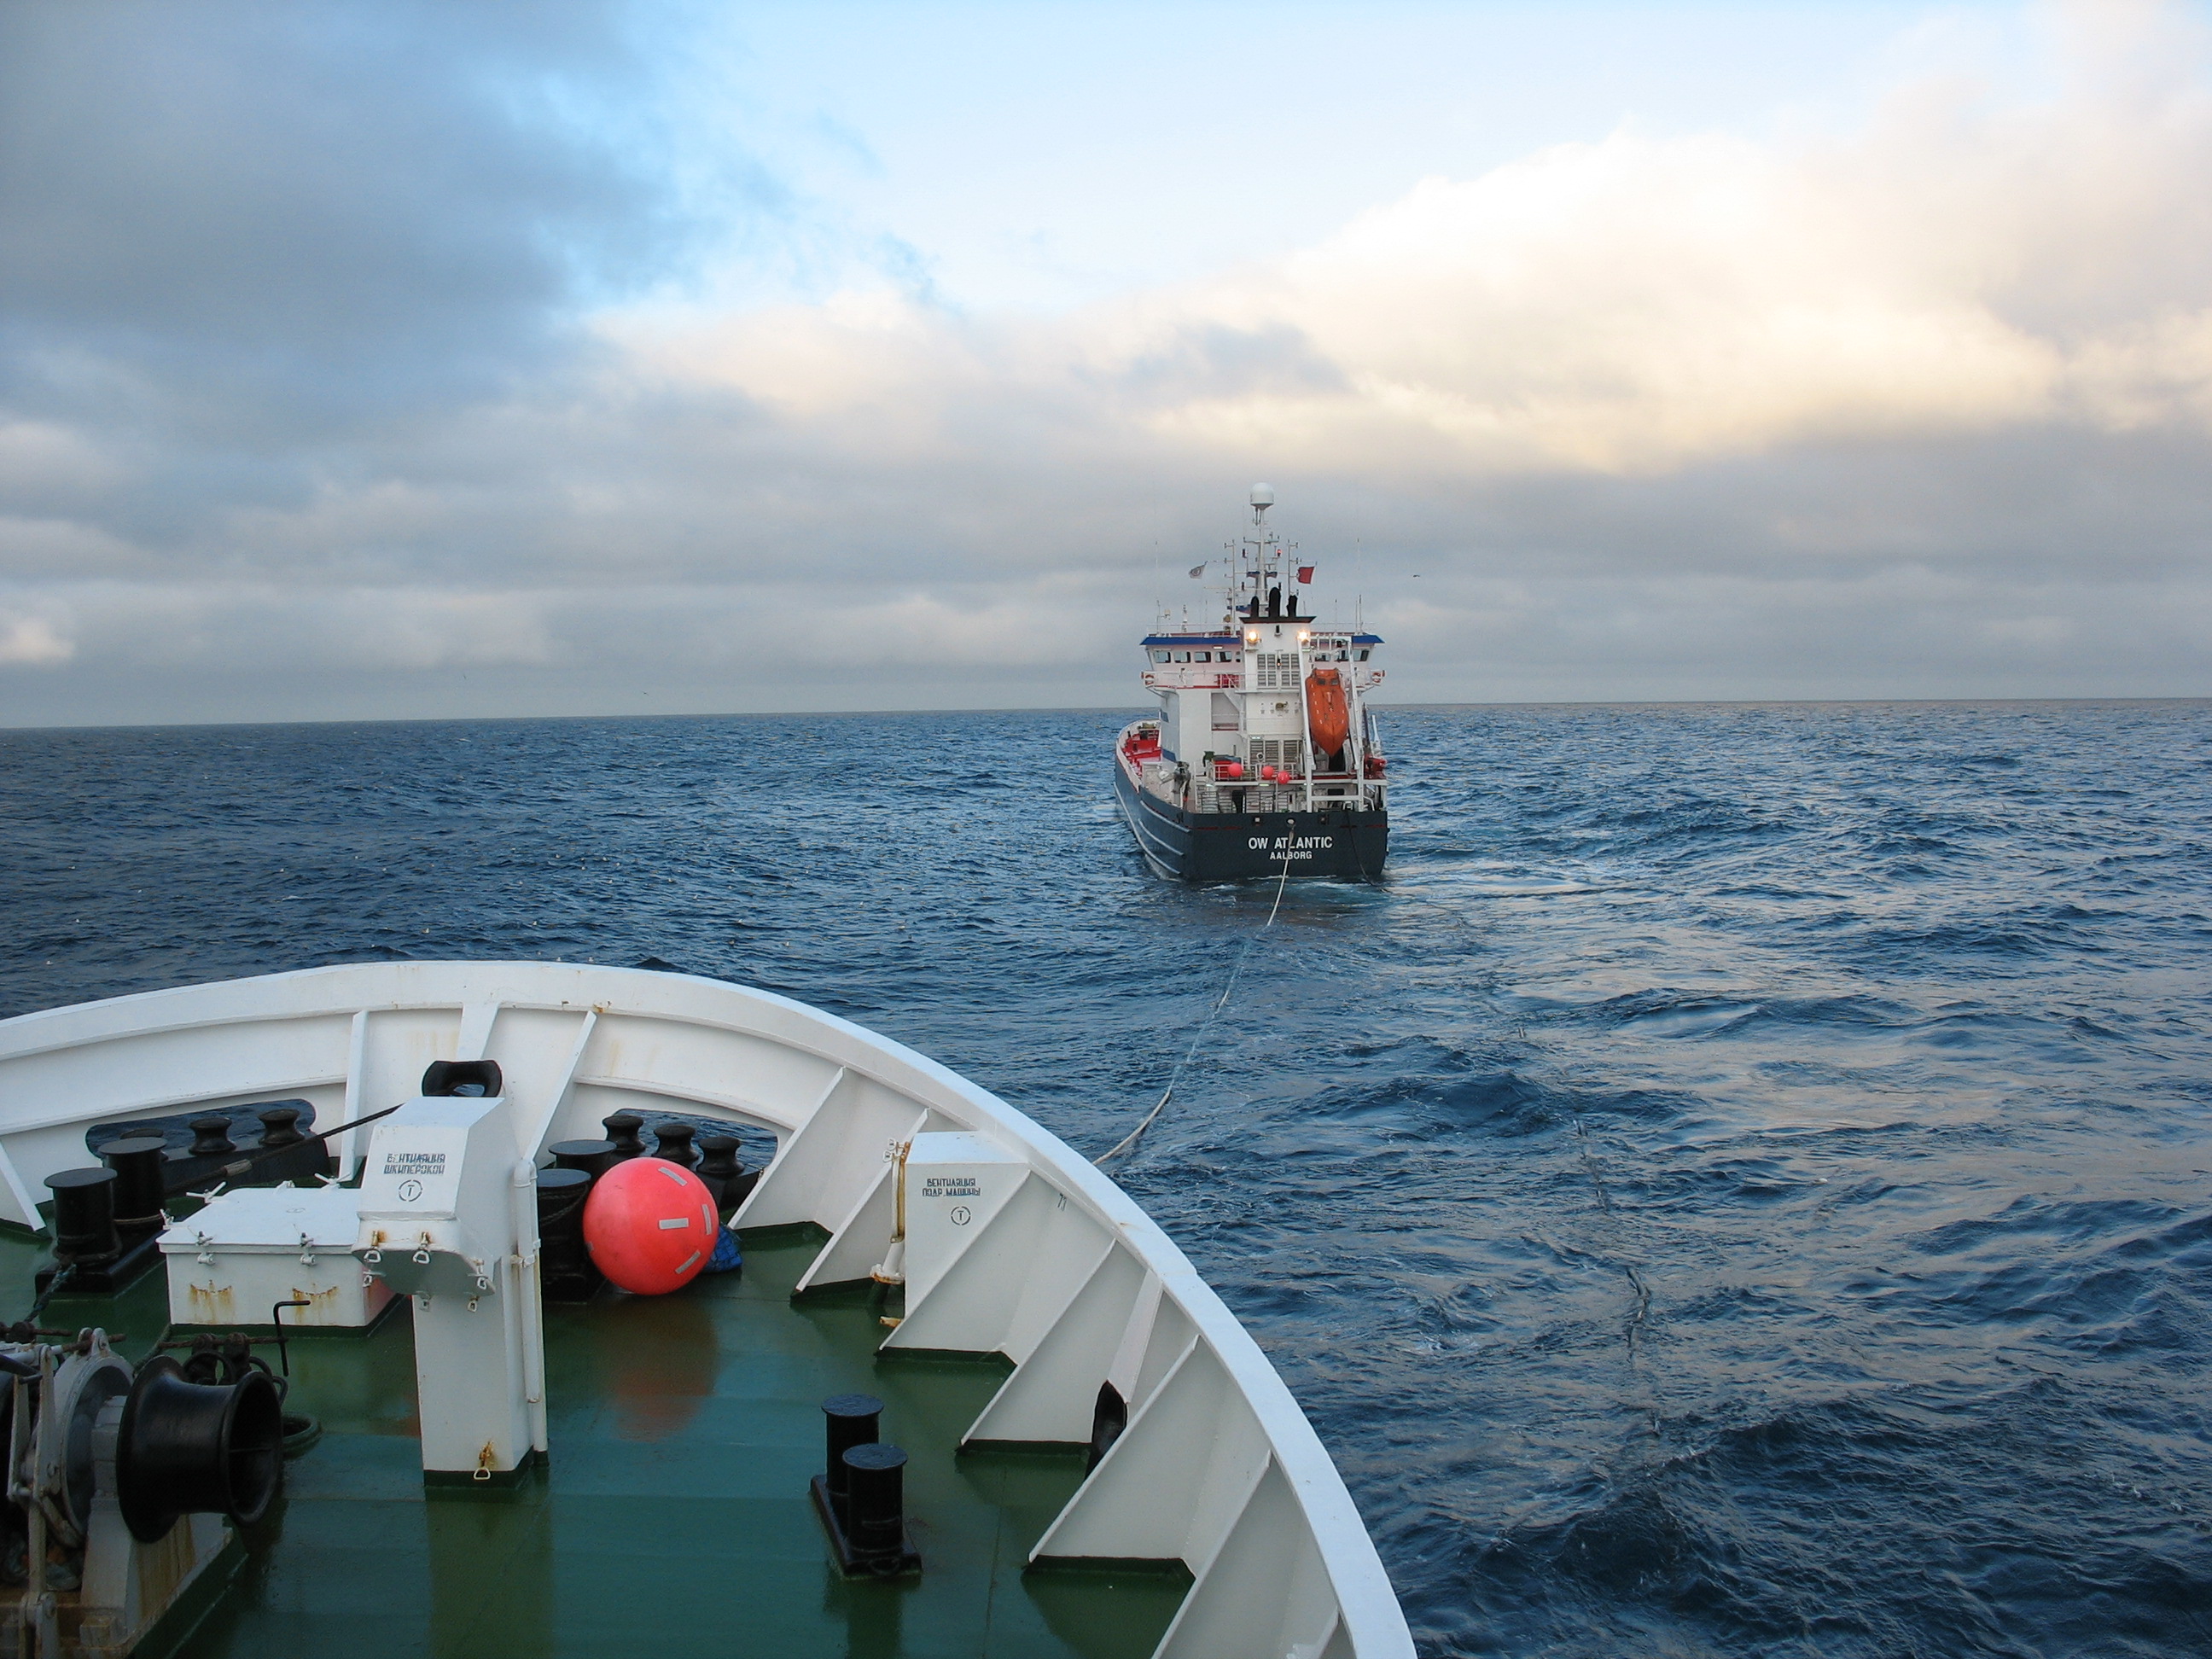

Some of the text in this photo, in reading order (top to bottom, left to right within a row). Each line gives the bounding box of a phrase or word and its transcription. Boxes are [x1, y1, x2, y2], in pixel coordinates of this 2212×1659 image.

[1248, 836, 1333, 850] OW ATLANTIC
[1269, 851, 1313, 860] AALBORG
